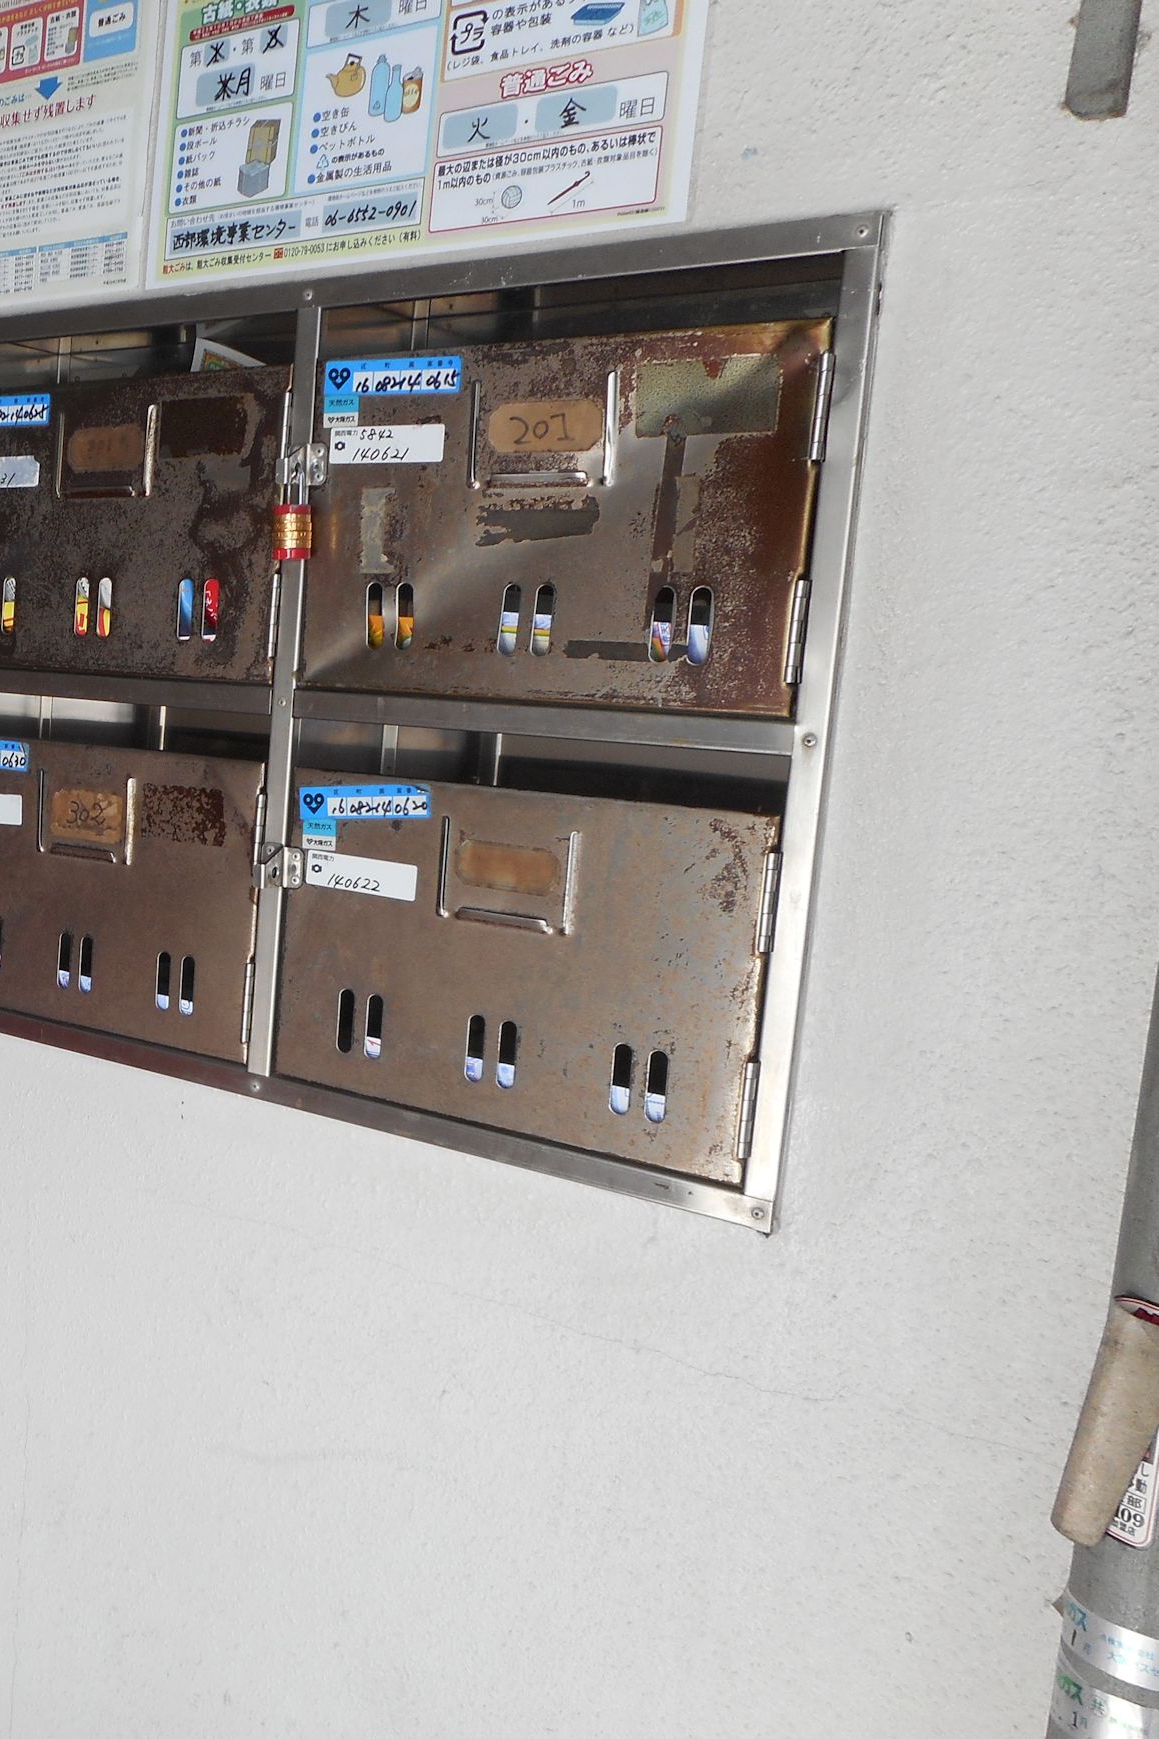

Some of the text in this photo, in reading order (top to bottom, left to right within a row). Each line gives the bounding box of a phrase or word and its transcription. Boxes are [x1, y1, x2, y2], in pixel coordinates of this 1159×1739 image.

[97, 12, 126, 27] 普通ごみ
[345, 5, 370, 29] 木
[491, 12, 552, 36] 容器や包装
[260, 72, 286, 90] 曜日
[500, 59, 593, 99] 普通ごみ
[0, 94, 96, 128] 収集せず残置します
[321, 107, 350, 121] 空き缶
[560, 97, 587, 129] 金
[619, 97, 655, 119] 曜日
[320, 121, 357, 137] 空きびん
[468, 117, 491, 143] 火
[187, 137, 217, 150] 段ボール
[319, 135, 375, 150] ペットボトル
[331, 148, 385, 164] の表示があるもの
[184, 167, 199, 178] 雑誌
[316, 160, 392, 183] 金属製の生活用品
[184, 177, 222, 192] その他の紙
[182, 195, 197, 205] 衣類
[572, 199, 586, 208] 1m
[325, 200, 417, 226] 06-6552-0901
[305, 216, 319, 227] 電話
[329, 398, 355, 406] 天然ガス
[360, 428, 393, 440] 5842
[353, 447, 409, 461] 140621
[66, 800, 107, 825] 302
[328, 873, 380, 892] 140622
